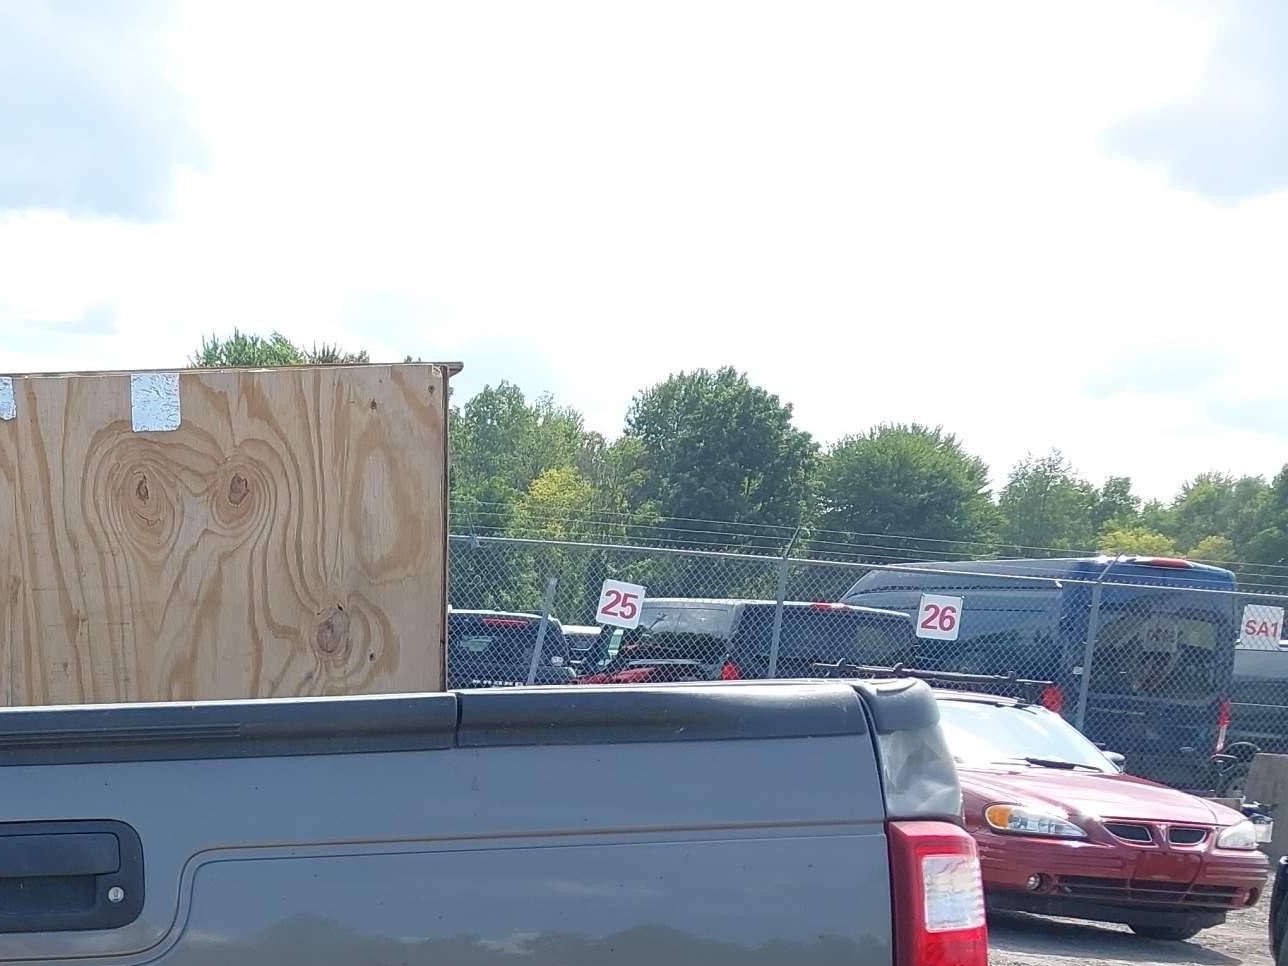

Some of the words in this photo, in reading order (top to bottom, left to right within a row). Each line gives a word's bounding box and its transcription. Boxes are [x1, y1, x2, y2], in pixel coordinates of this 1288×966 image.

[600, 589, 639, 620] 25
[920, 604, 957, 632] 26
[1245, 619, 1279, 640] SA1
